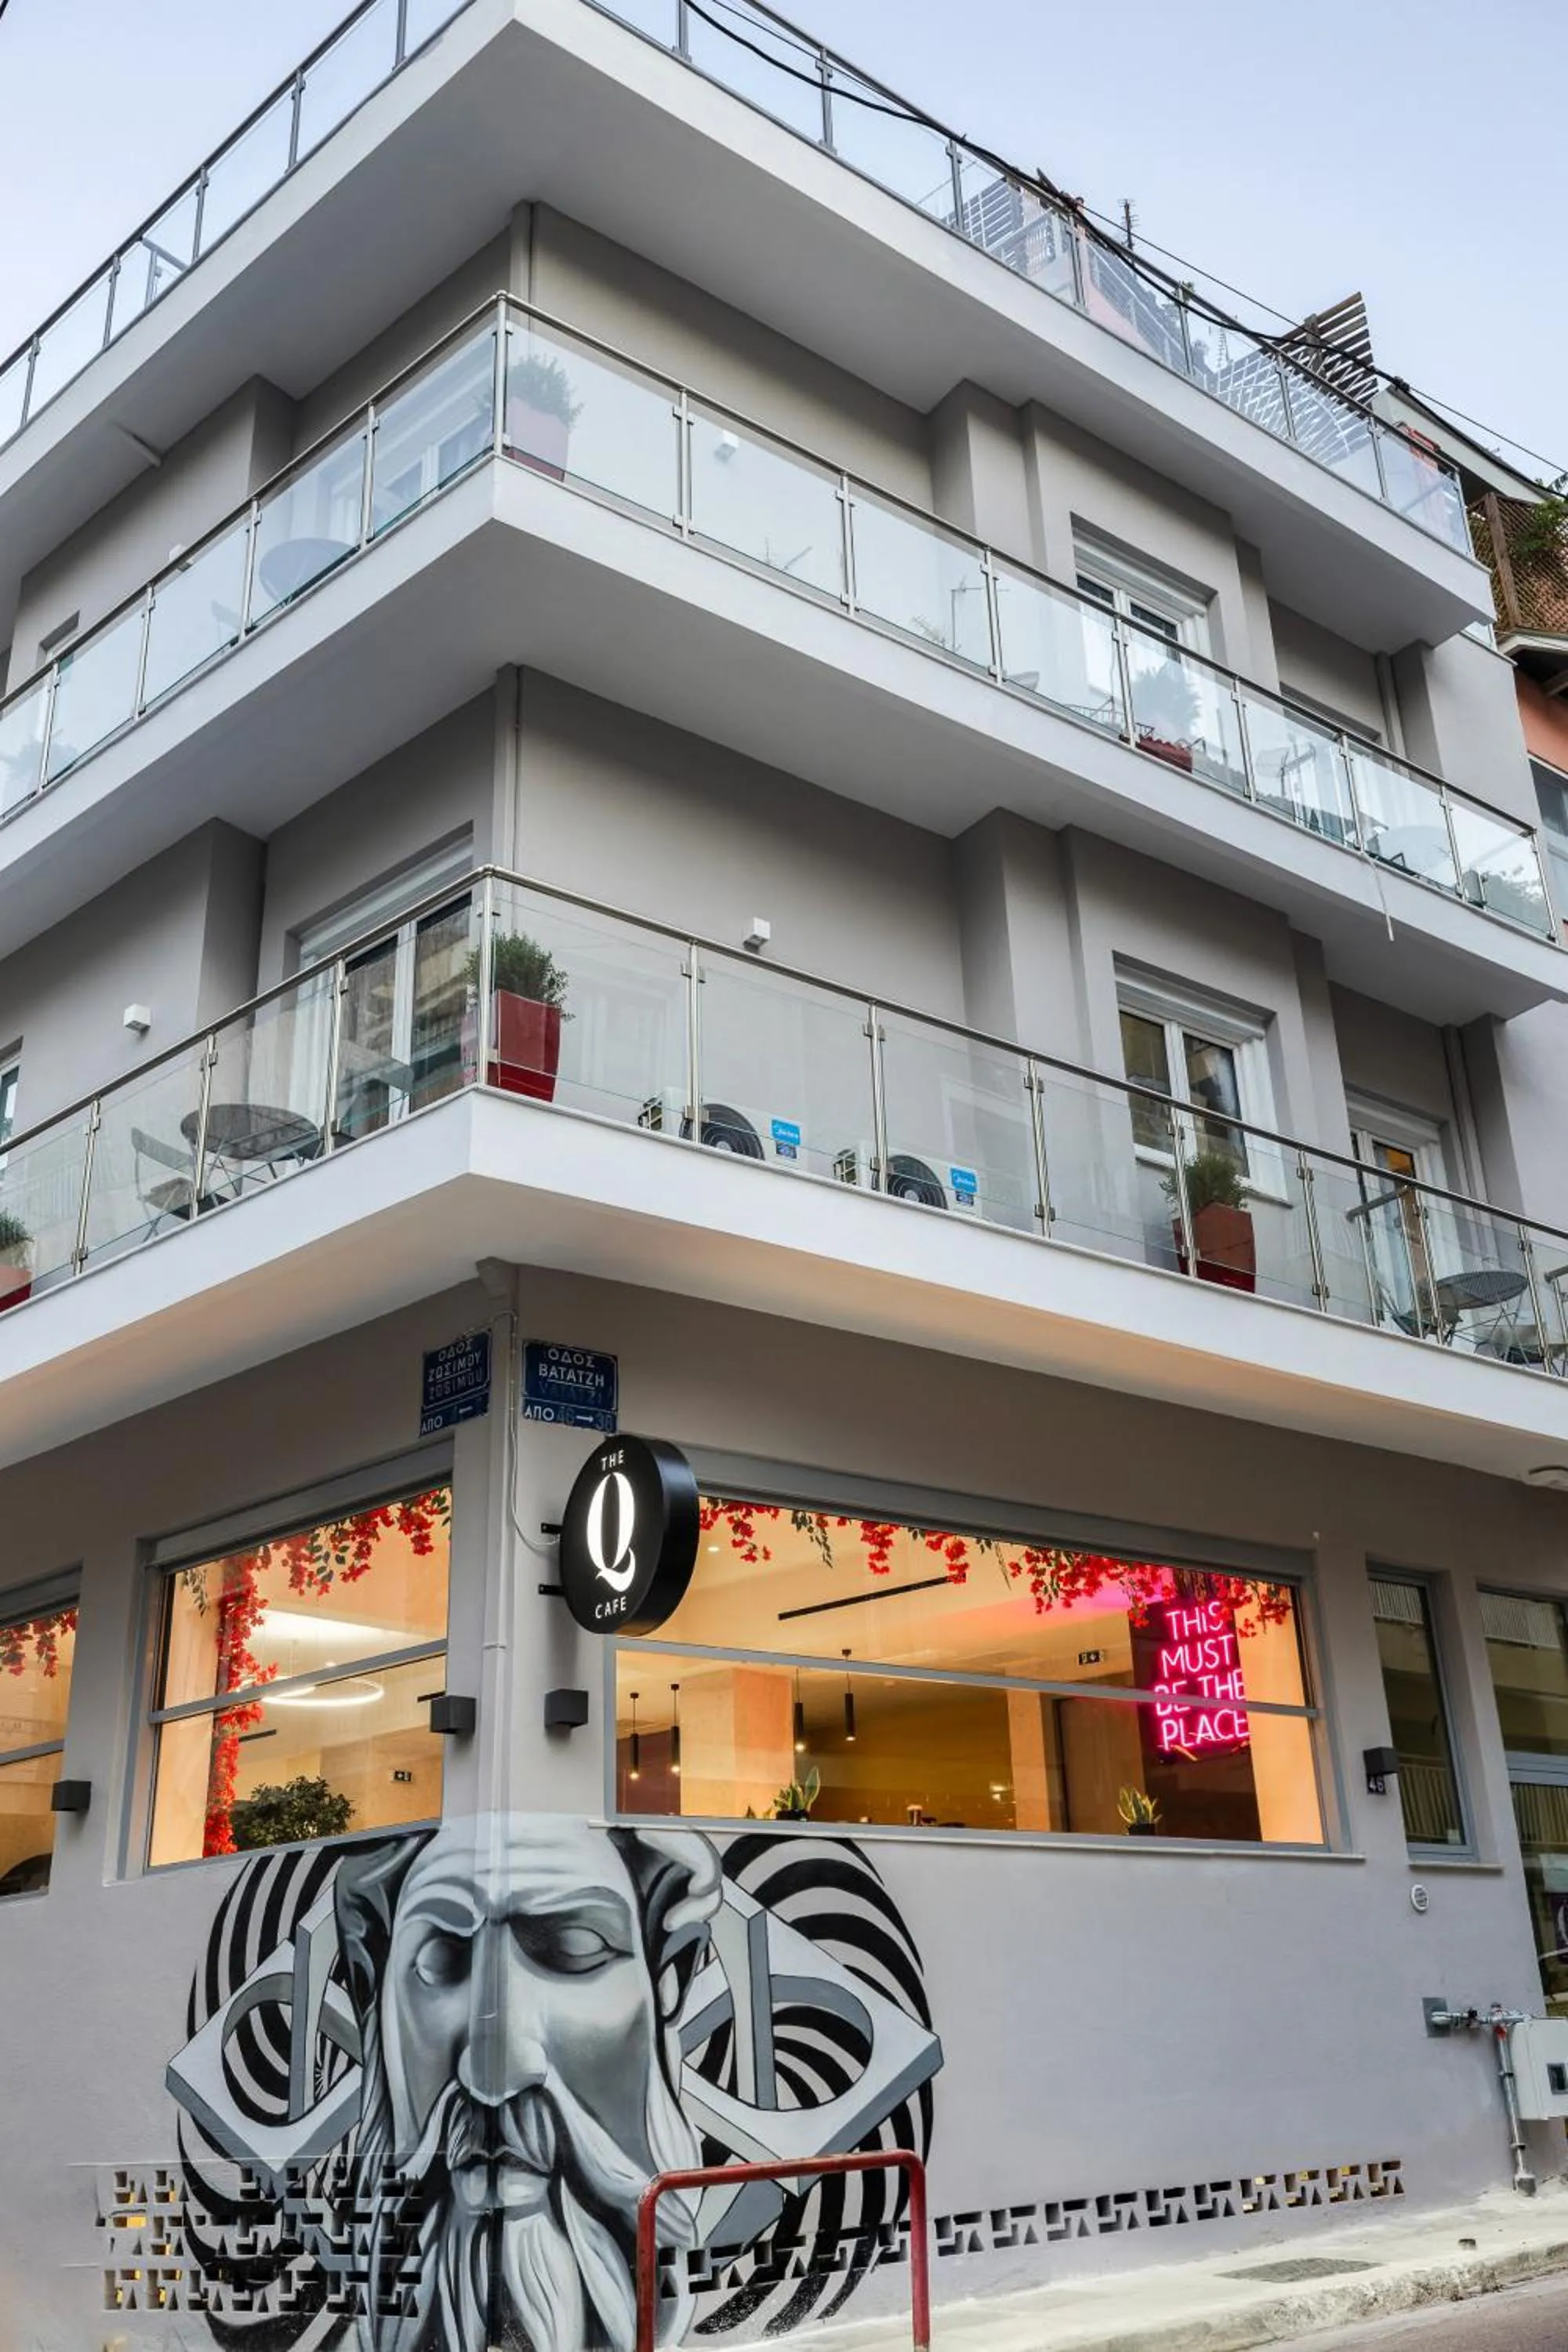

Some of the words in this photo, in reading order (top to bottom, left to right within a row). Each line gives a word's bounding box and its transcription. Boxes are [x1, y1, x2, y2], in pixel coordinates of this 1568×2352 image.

[438, 1338, 474, 1363] ΟΔΟΣ
[548, 1348, 596, 1368] ΟΔΟΣ
[428, 1351, 482, 1382] ΖΩΣΙΜΟΥ
[539, 1363, 604, 1388] ΒΑΤΑΤΖΗ
[421, 1416, 444, 1434] ΑΠΟ
[524, 1404, 555, 1421] ΑΠΟ
[601, 1450, 625, 1472] THE
[586, 1471, 637, 1592] Q
[594, 1595, 628, 1619] CAFE
[1165, 1601, 1224, 1640] THIS
[1160, 1633, 1235, 1679] MUST
[1197, 1668, 1246, 1700] THE
[1160, 1708, 1251, 1751] PLACE
